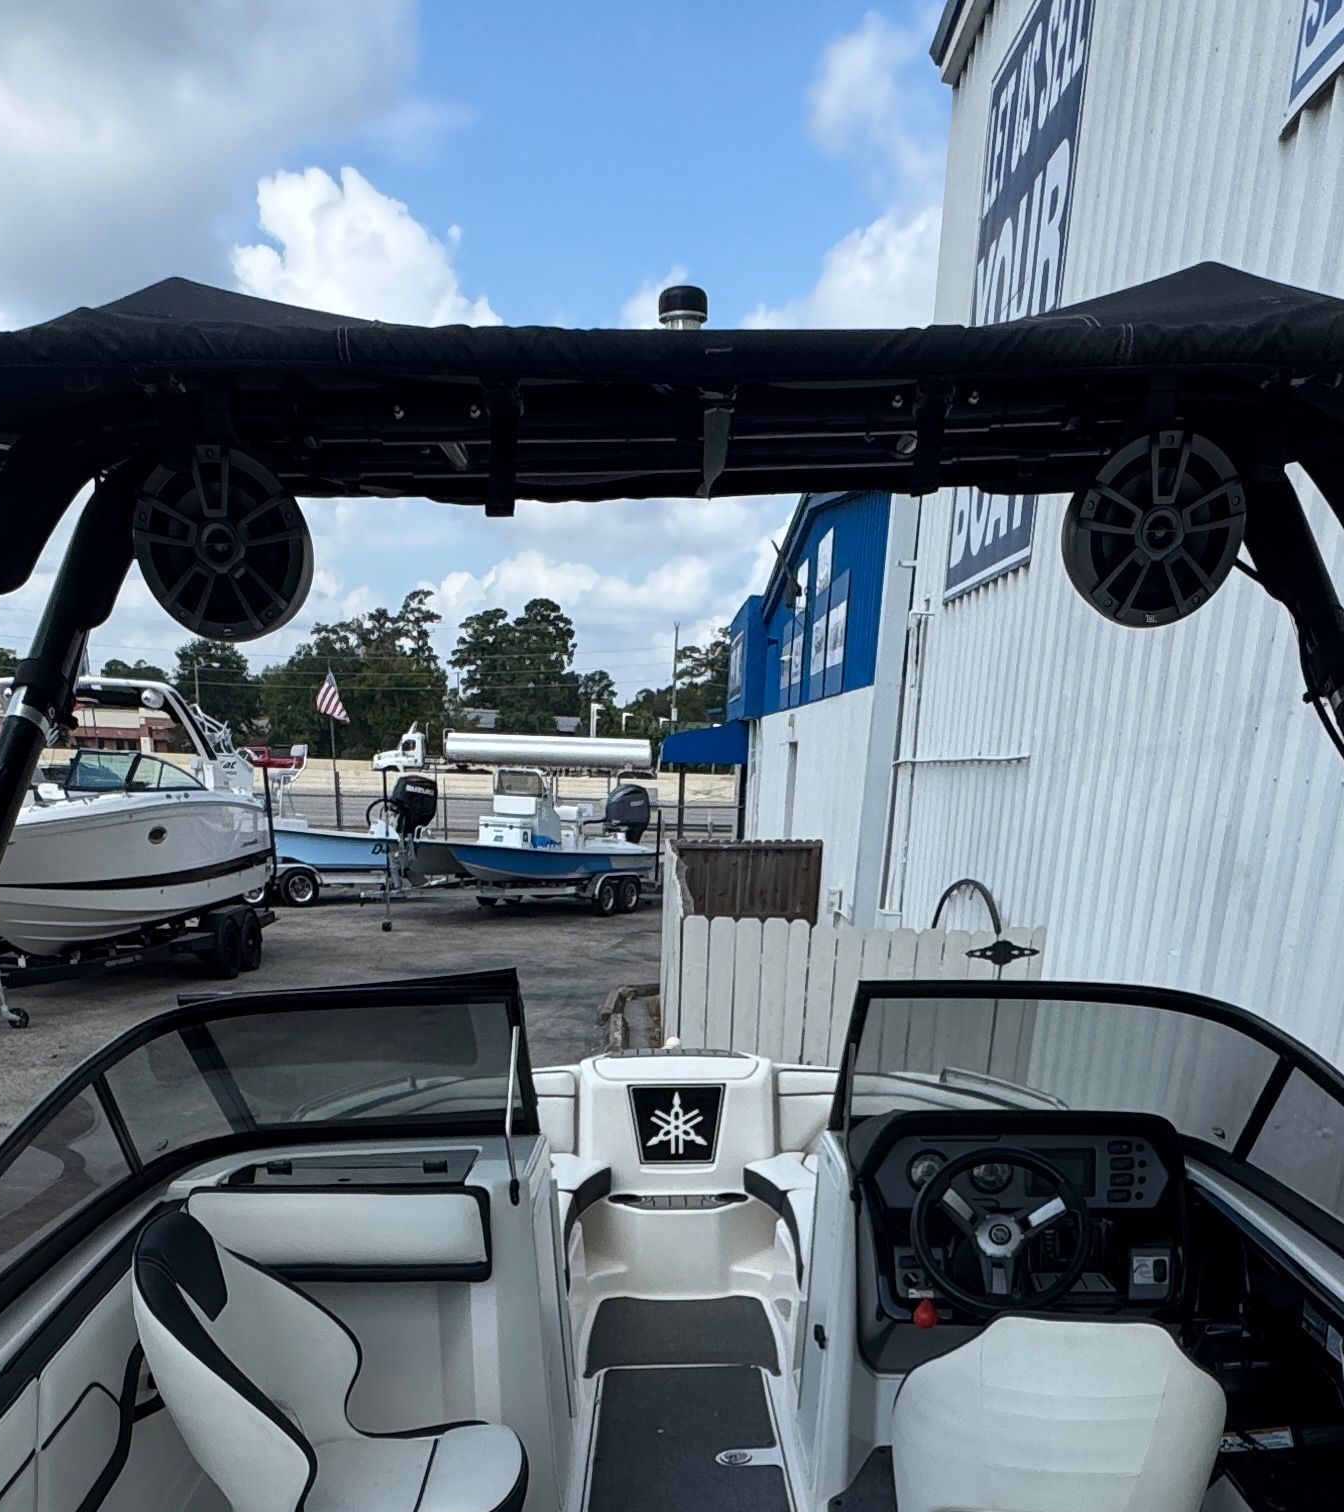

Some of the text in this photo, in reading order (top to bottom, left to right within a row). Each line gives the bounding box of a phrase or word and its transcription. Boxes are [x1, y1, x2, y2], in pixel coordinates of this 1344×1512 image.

[982, 0, 1086, 221] LET US SELL
[975, 138, 1071, 327] YOUR
